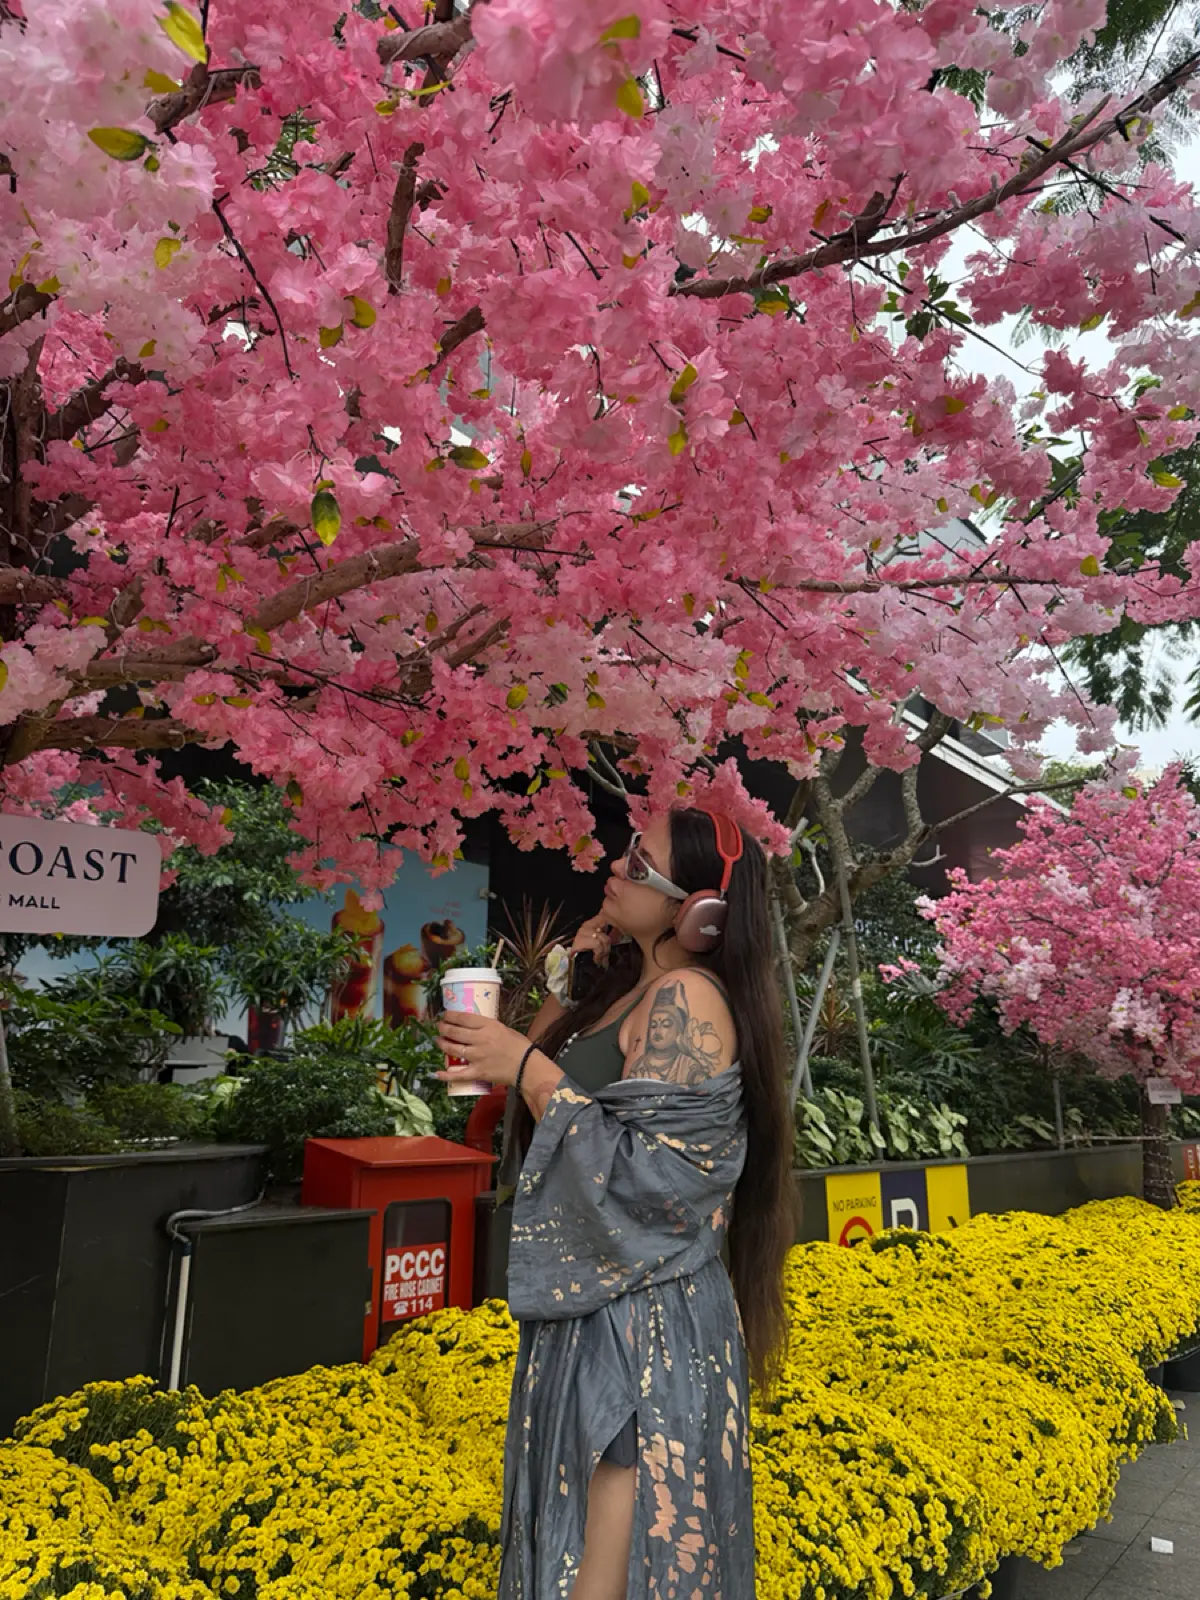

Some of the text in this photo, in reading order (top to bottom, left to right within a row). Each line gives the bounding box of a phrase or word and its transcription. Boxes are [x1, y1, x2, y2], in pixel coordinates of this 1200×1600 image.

[0, 840, 137, 883] OAST
[9, 894, 60, 909] MALL
[832, 1196, 876, 1212] NO PARKING
[384, 1247, 445, 1282] PCCC
[383, 1276, 444, 1301] FIRE HOSE CABINET
[410, 1295, 433, 1312] 114
